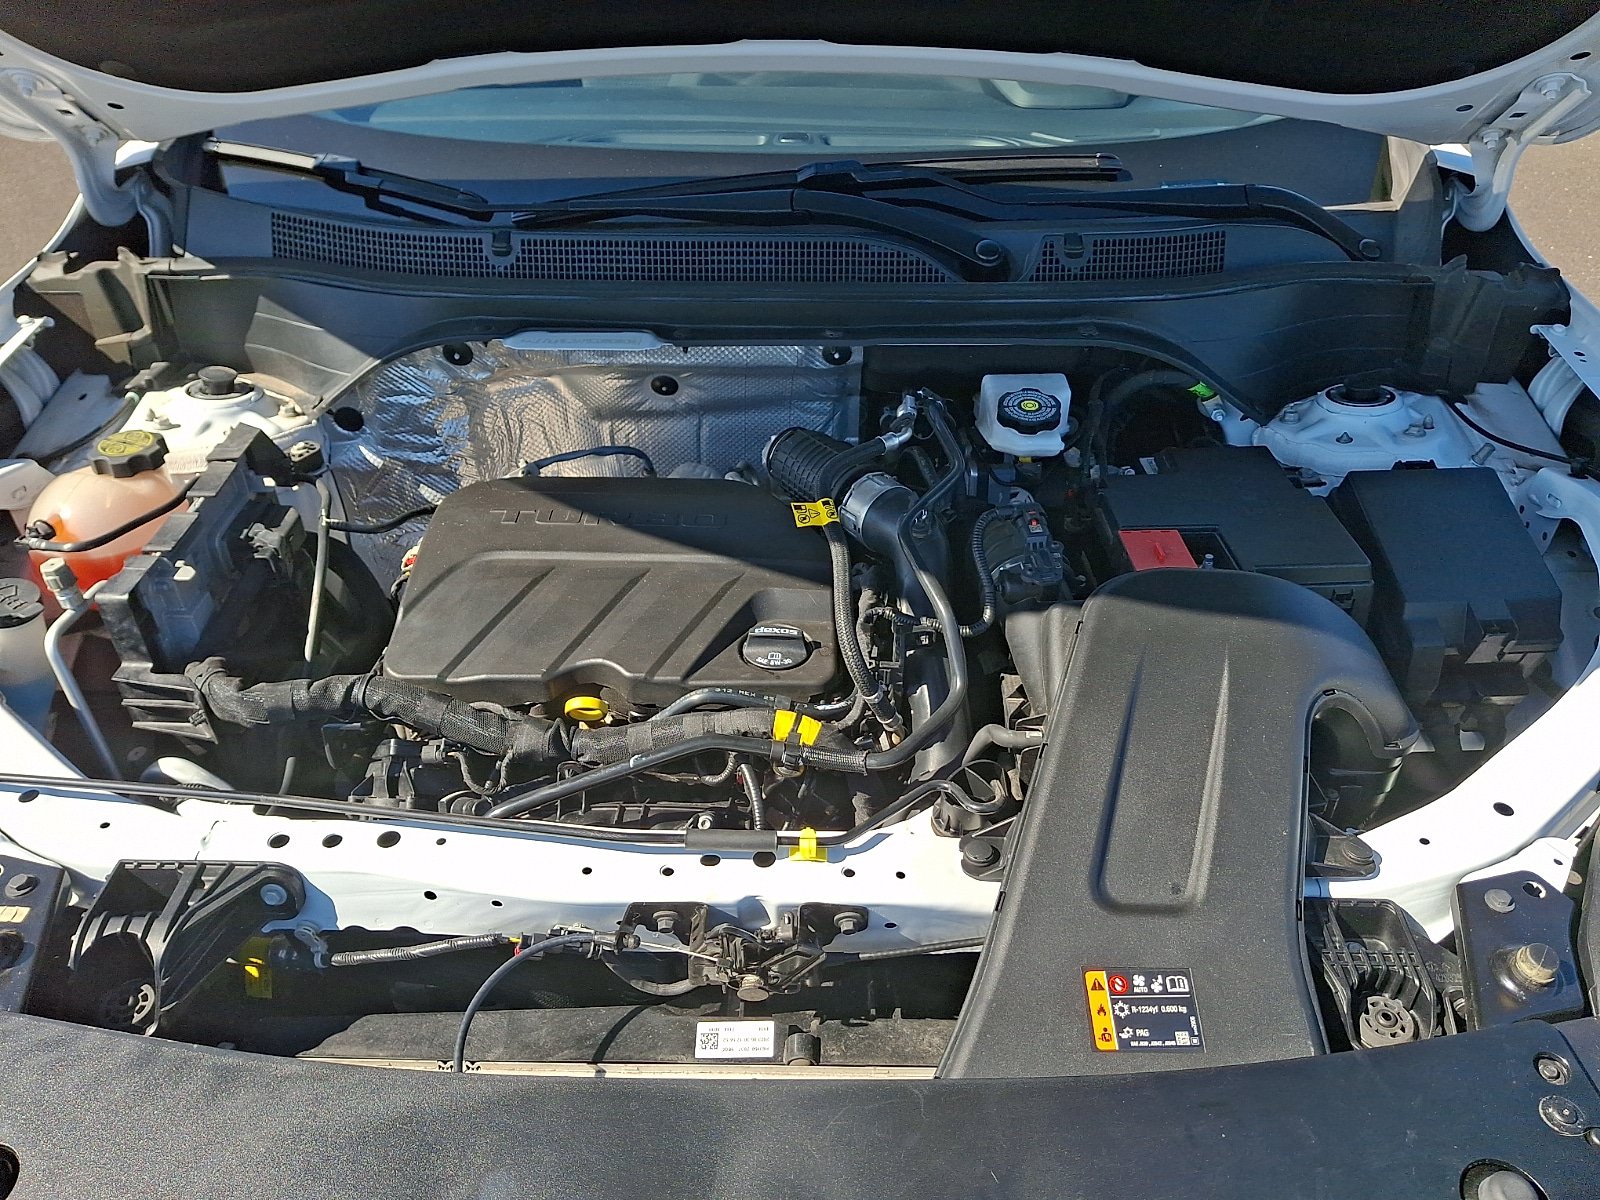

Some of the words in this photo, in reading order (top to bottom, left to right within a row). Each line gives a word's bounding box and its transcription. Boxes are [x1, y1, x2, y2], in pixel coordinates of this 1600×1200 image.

[489, 508, 729, 528] TURBO
[754, 627, 798, 635] dexos
[1135, 1028, 1150, 1037] PAG
